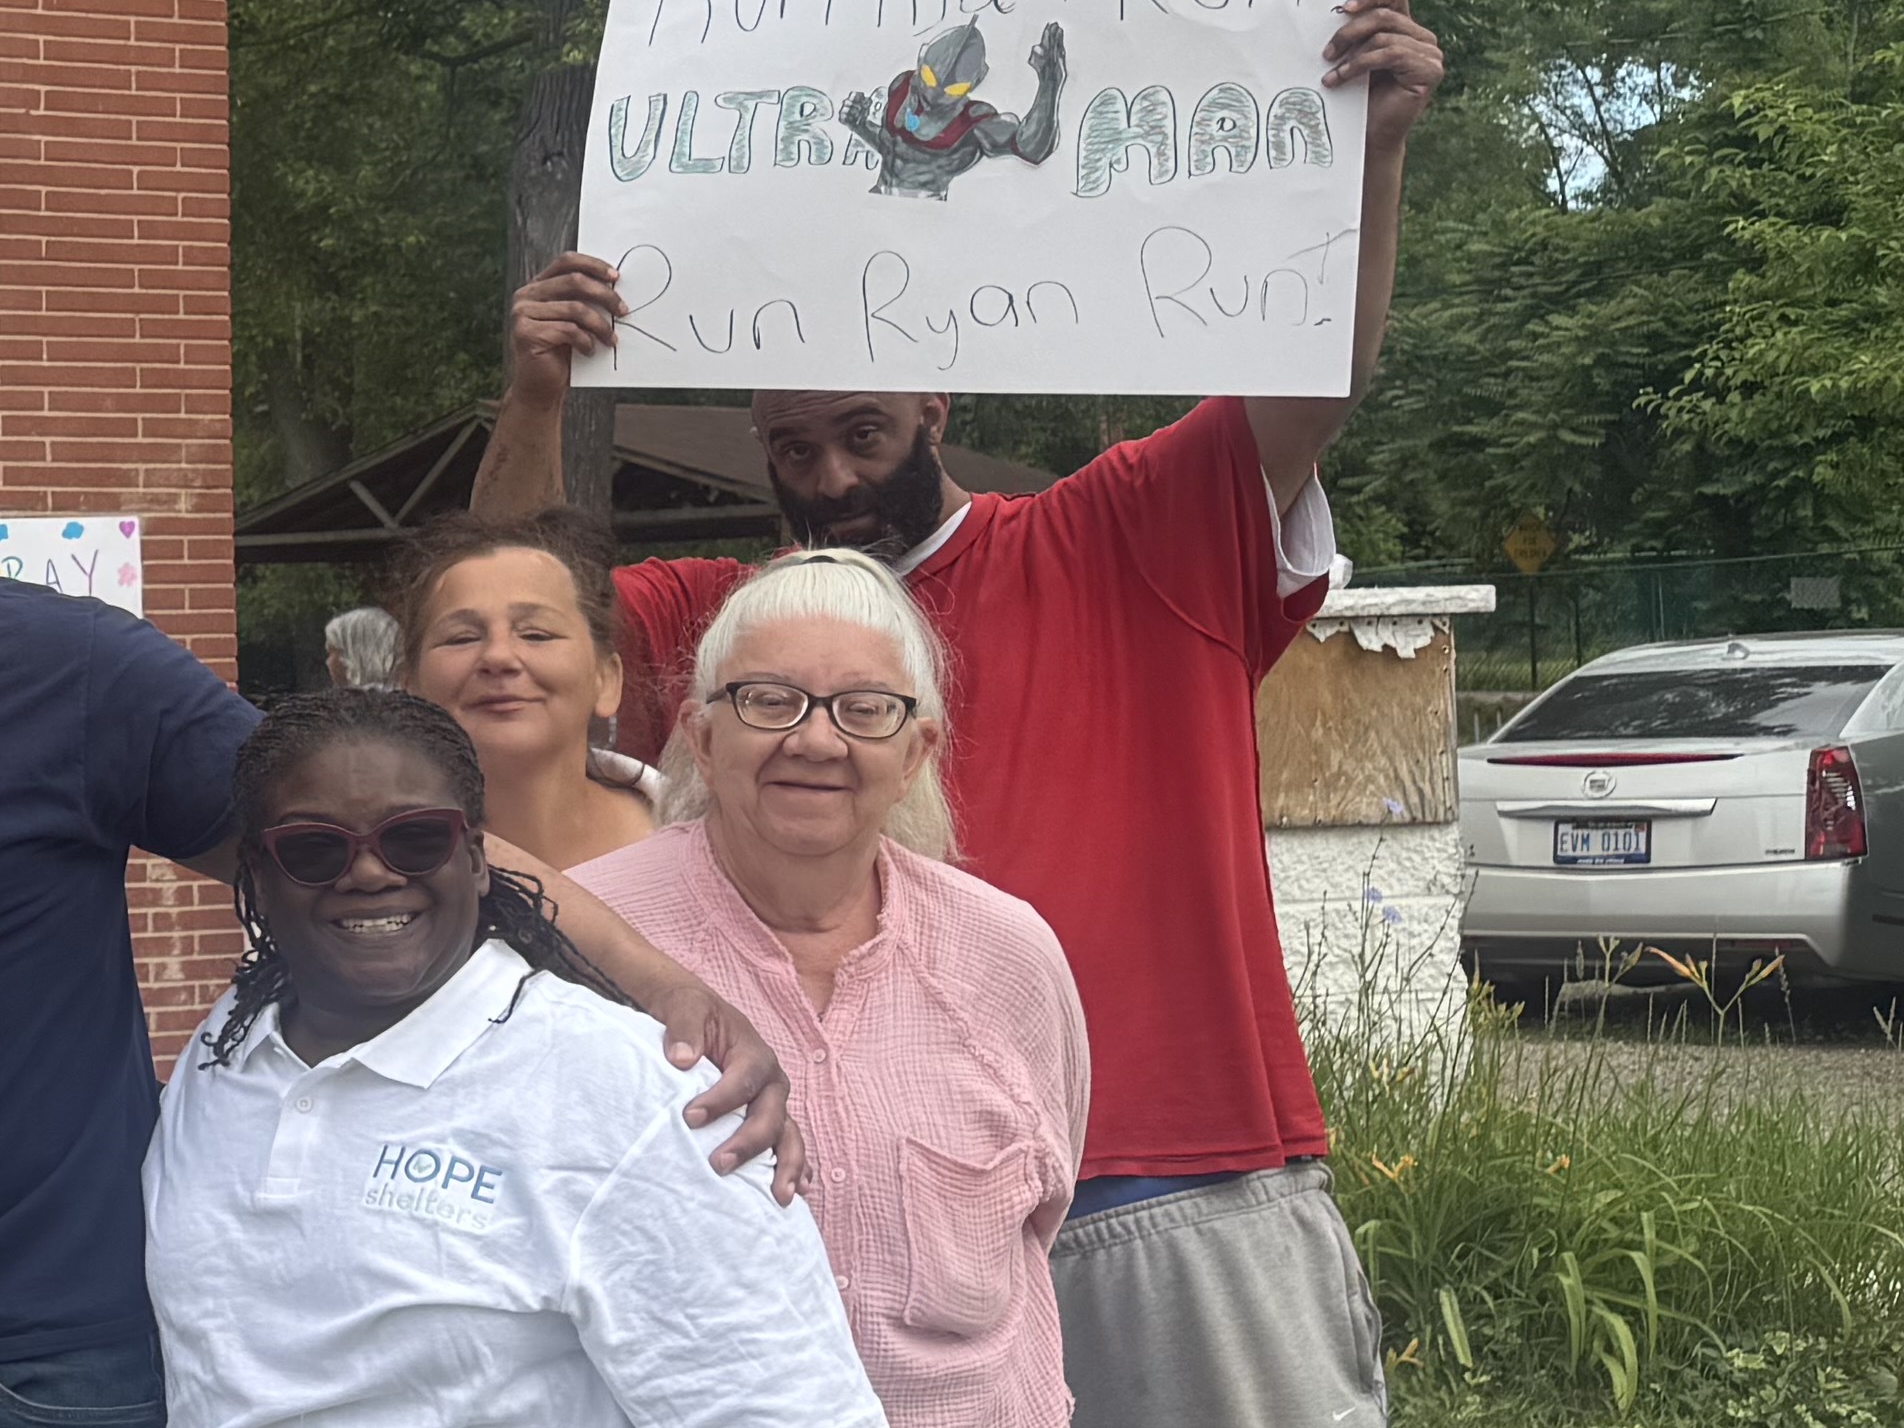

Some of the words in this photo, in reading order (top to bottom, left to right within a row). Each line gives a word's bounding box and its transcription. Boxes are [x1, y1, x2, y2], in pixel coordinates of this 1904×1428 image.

[1073, 82, 1334, 198] MAN
[611, 243, 806, 372] Run
[862, 250, 1080, 372] Ryan
[365, 1182, 489, 1231] shelters
[372, 1143, 504, 1205] HOPE
